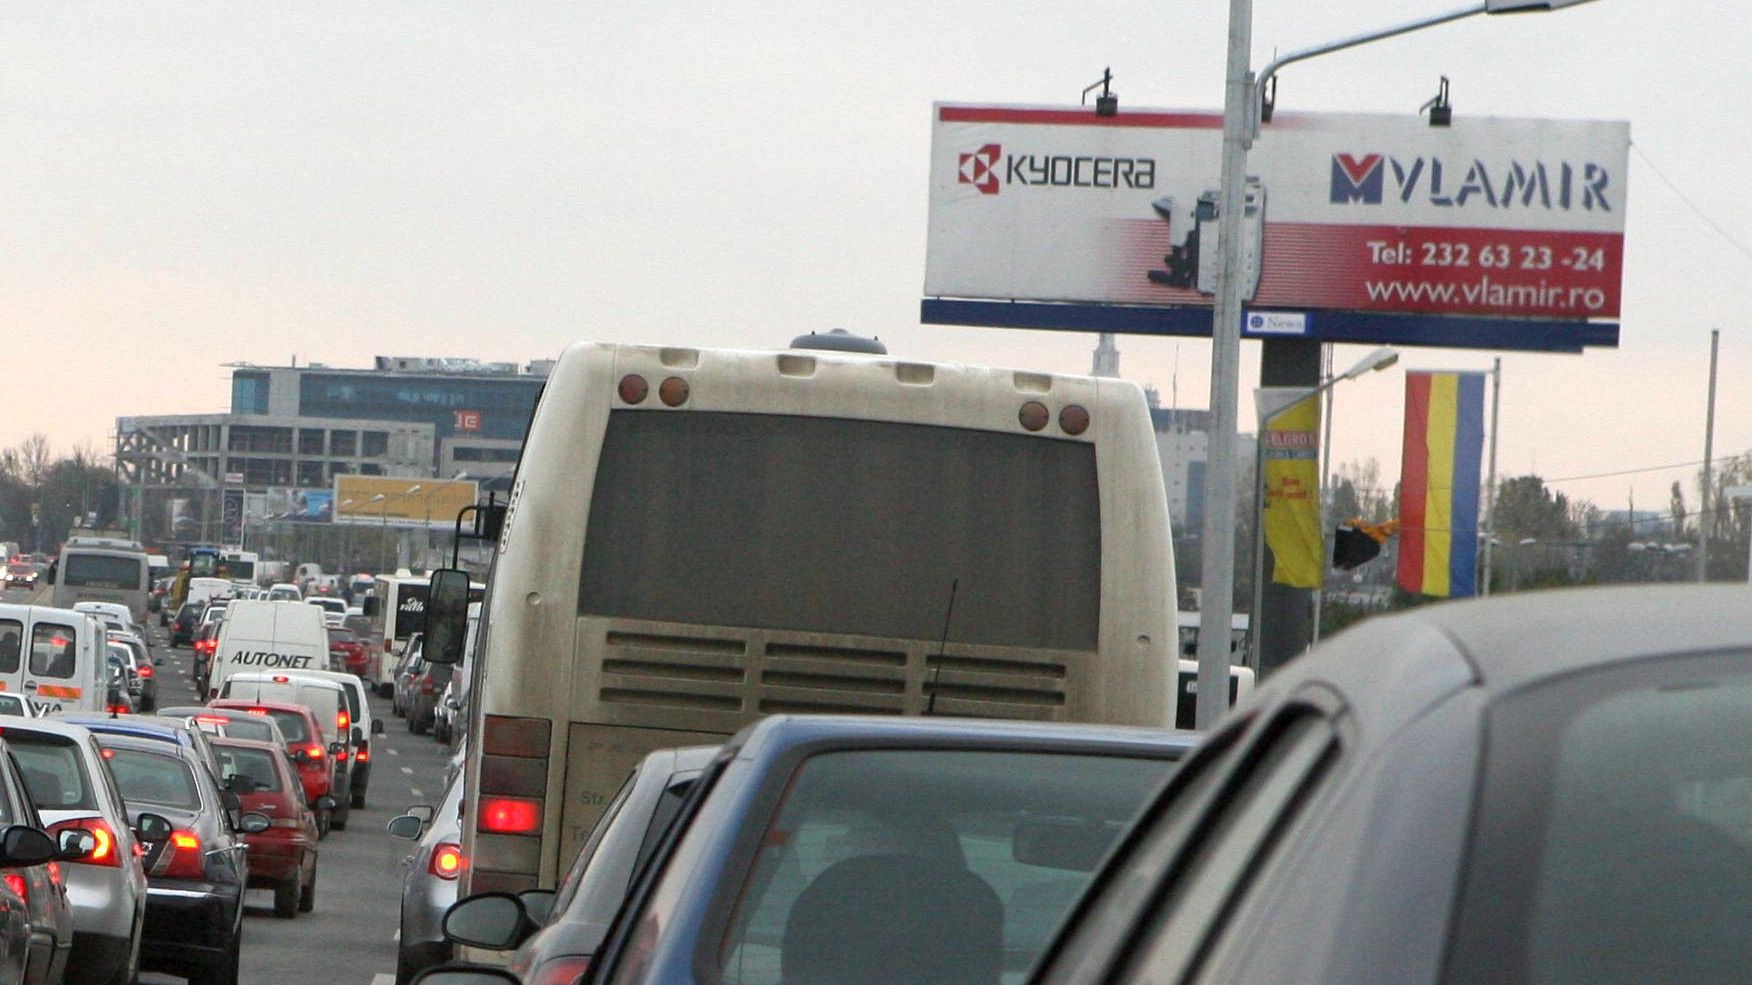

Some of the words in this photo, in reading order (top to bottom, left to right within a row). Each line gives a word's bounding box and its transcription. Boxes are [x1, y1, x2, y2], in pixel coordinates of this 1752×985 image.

[1005, 154, 1156, 190] KYOCERA
[1388, 156, 1612, 213] VLAMIR
[1366, 240, 1412, 266] Tel:
[1422, 242, 1469, 267] 232
[1478, 244, 1511, 269] 63
[1520, 246, 1552, 270] 23
[1365, 276, 1606, 311] www.vlamir.ro
[230, 650, 313, 669] AUTONET
